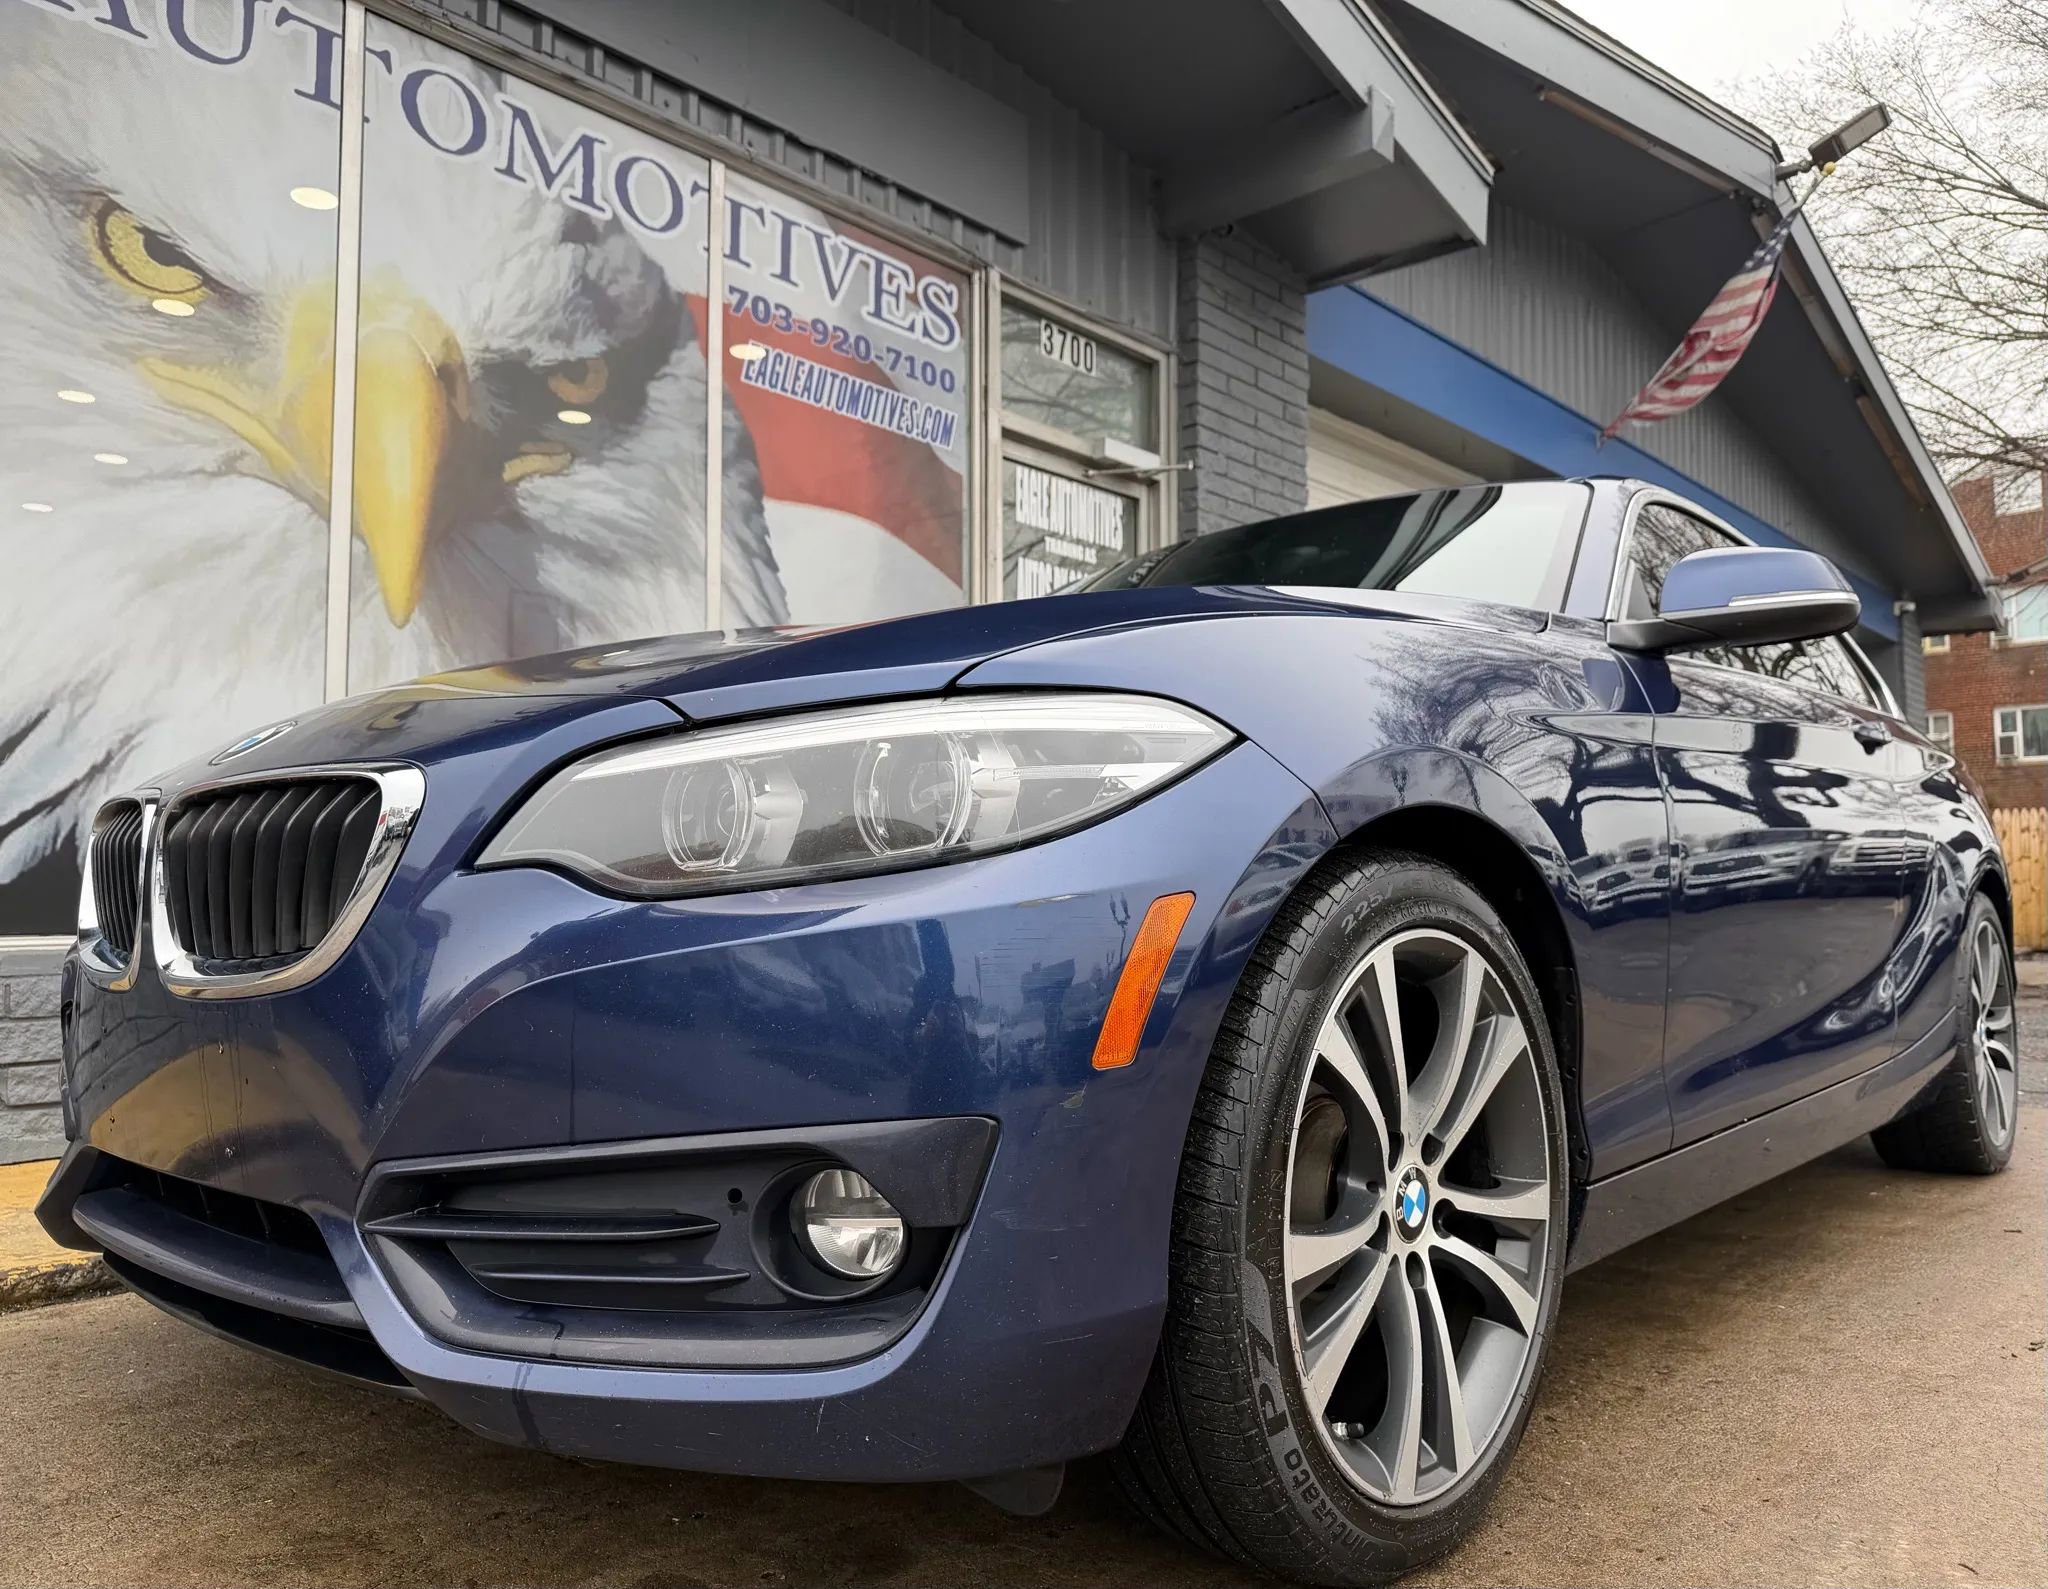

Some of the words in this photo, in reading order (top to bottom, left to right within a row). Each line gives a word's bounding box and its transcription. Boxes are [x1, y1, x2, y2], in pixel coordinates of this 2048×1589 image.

[728, 285, 956, 394] 703-920-7100
[1043, 322, 1093, 373] 3700
[743, 342, 958, 447] EAGLEAUTOMOTIVES.COM
[1016, 465, 1050, 531] EAGLE
[1050, 474, 1123, 552] AUTOMOTIVES
